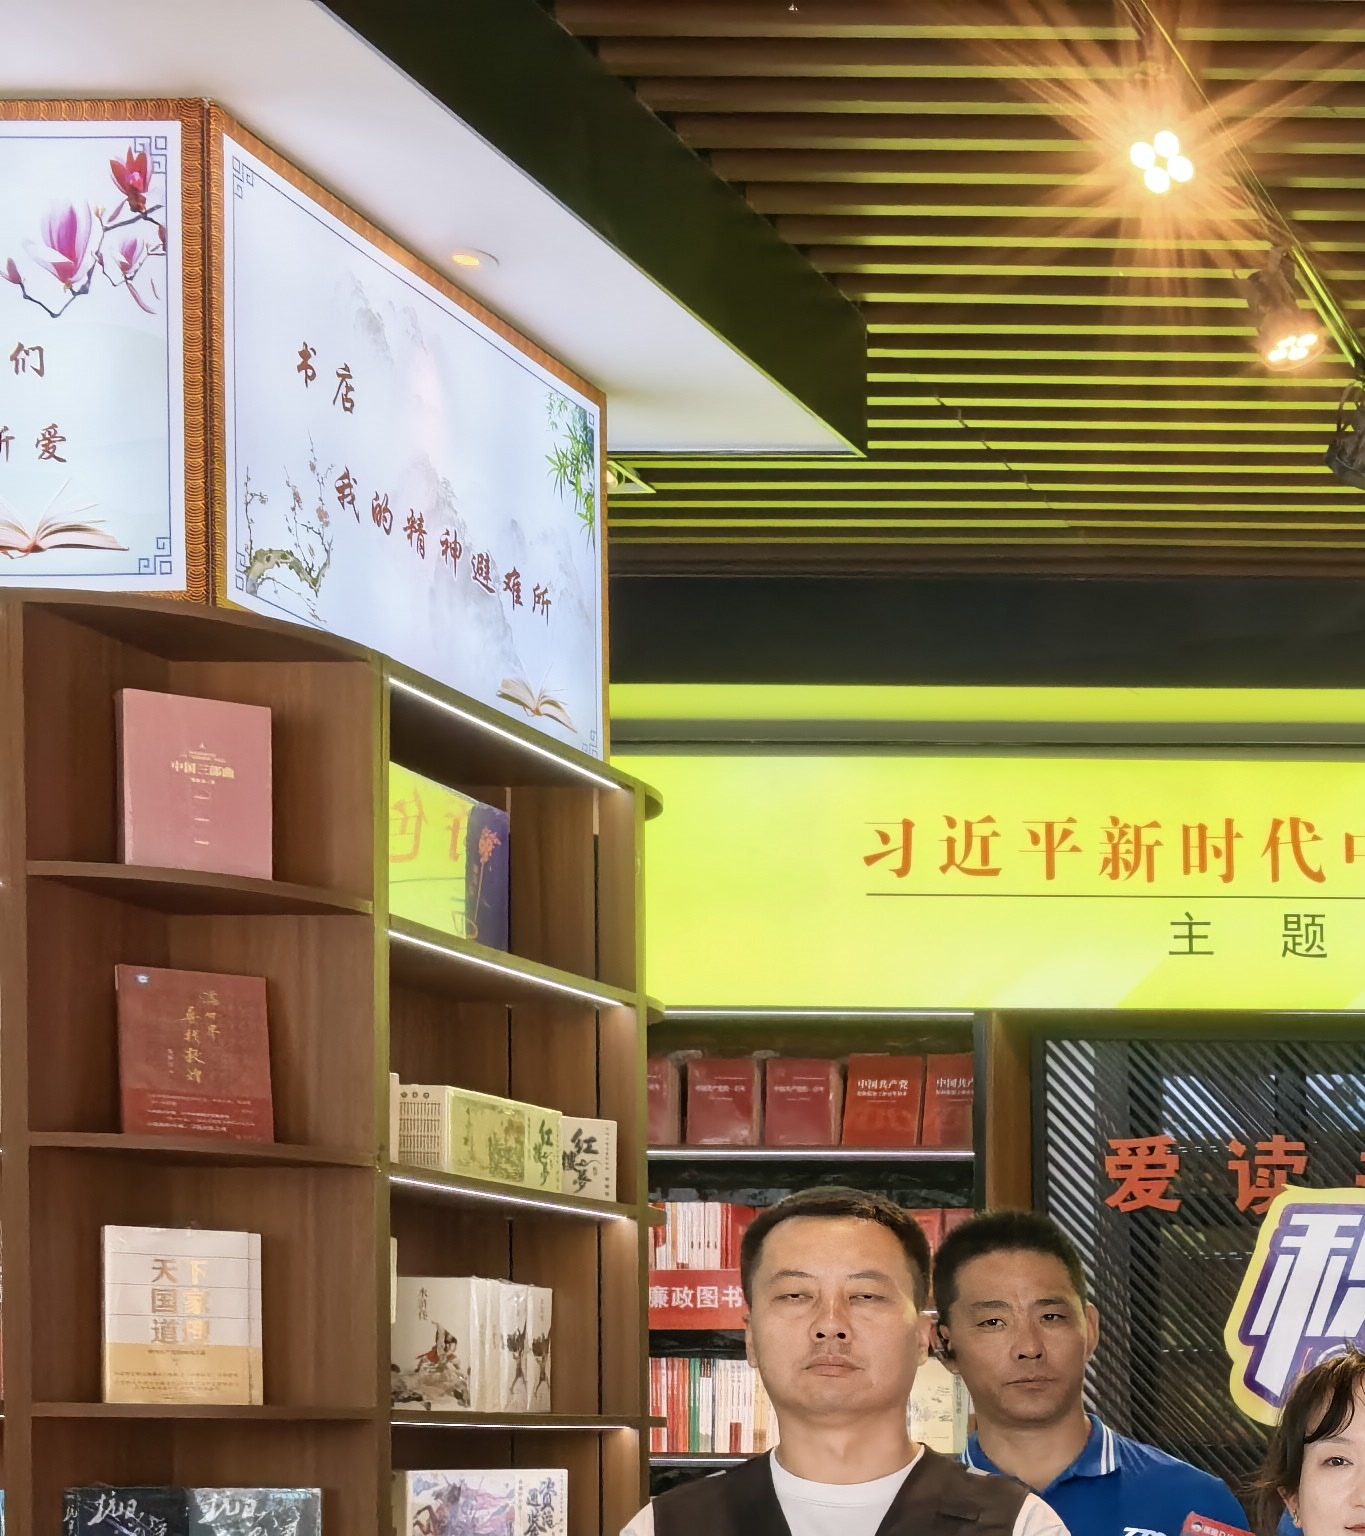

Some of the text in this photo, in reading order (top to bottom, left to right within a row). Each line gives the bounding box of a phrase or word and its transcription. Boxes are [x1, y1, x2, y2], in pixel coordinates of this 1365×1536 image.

[10, 342, 45, 379] 们
[295, 341, 359, 415] 书店
[334, 467, 553, 627] 我的精神避难所
[649, 1285, 743, 1309] 廉政图书
